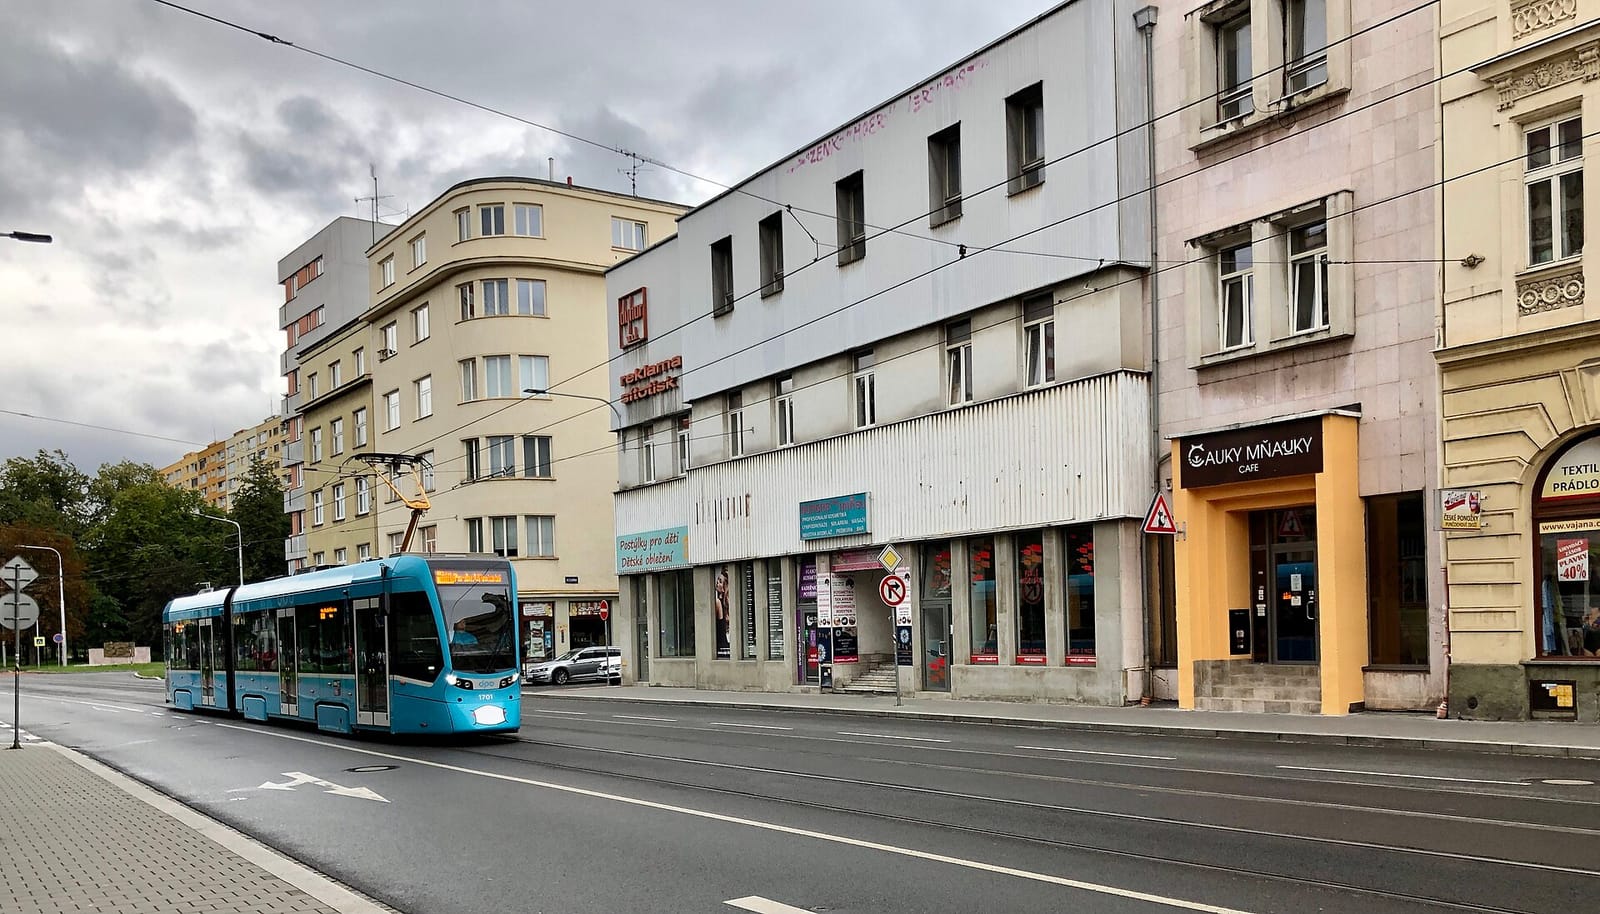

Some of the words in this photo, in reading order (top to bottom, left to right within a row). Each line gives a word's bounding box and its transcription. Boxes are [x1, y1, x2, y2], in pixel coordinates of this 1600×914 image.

[620, 356, 682, 386] reklama
[1238, 463, 1259, 474] CAFE
[1561, 463, 1599, 476] TEXTIL
[1552, 479, 1599, 492] PRÁDLO
[620, 536, 647, 552] Postýlky
[650, 536, 662, 550] pro
[665, 531, 680, 544] děti
[621, 555, 643, 567] Dětské
[645, 550, 674, 565] oblečení
[1559, 553, 1587, 567] PLAVKY
[1560, 564, 1586, 579] -40%
